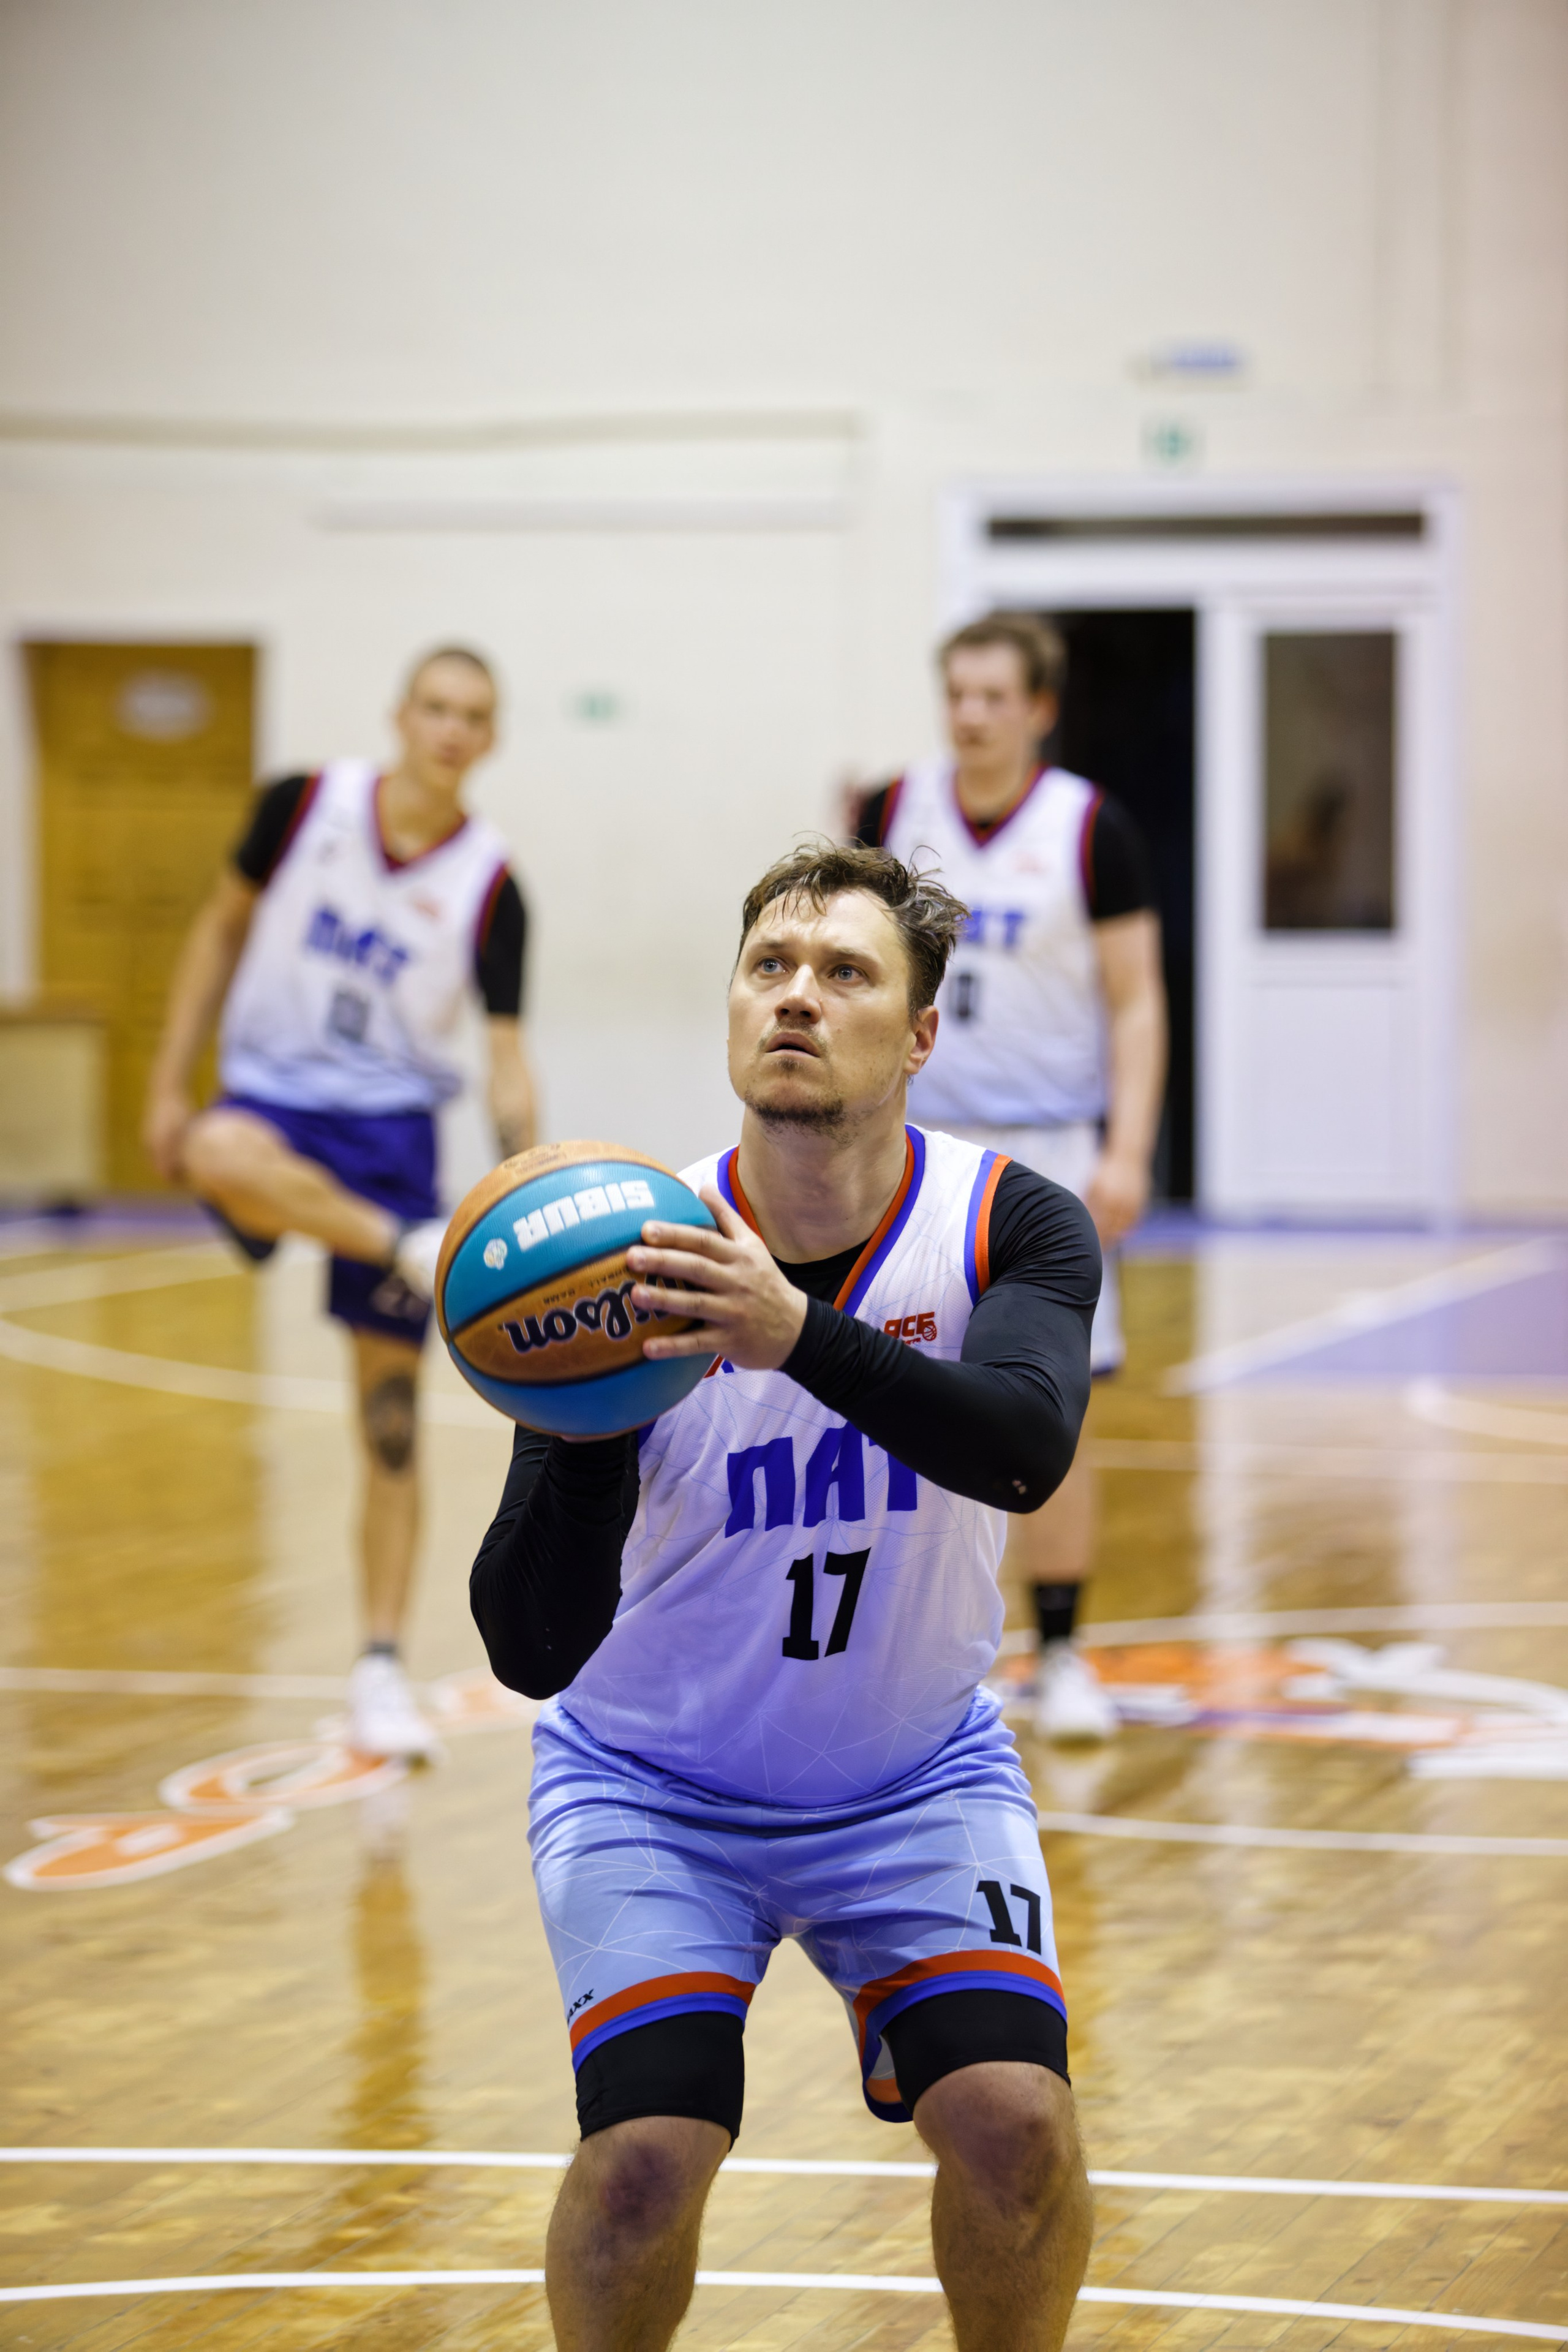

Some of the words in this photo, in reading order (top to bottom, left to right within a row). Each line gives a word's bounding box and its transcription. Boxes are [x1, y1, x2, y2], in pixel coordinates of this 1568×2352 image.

[512, 1180, 656, 1252] SIBUR
[782, 1547, 872, 1661] 17
[976, 1880, 1042, 1956] 17
